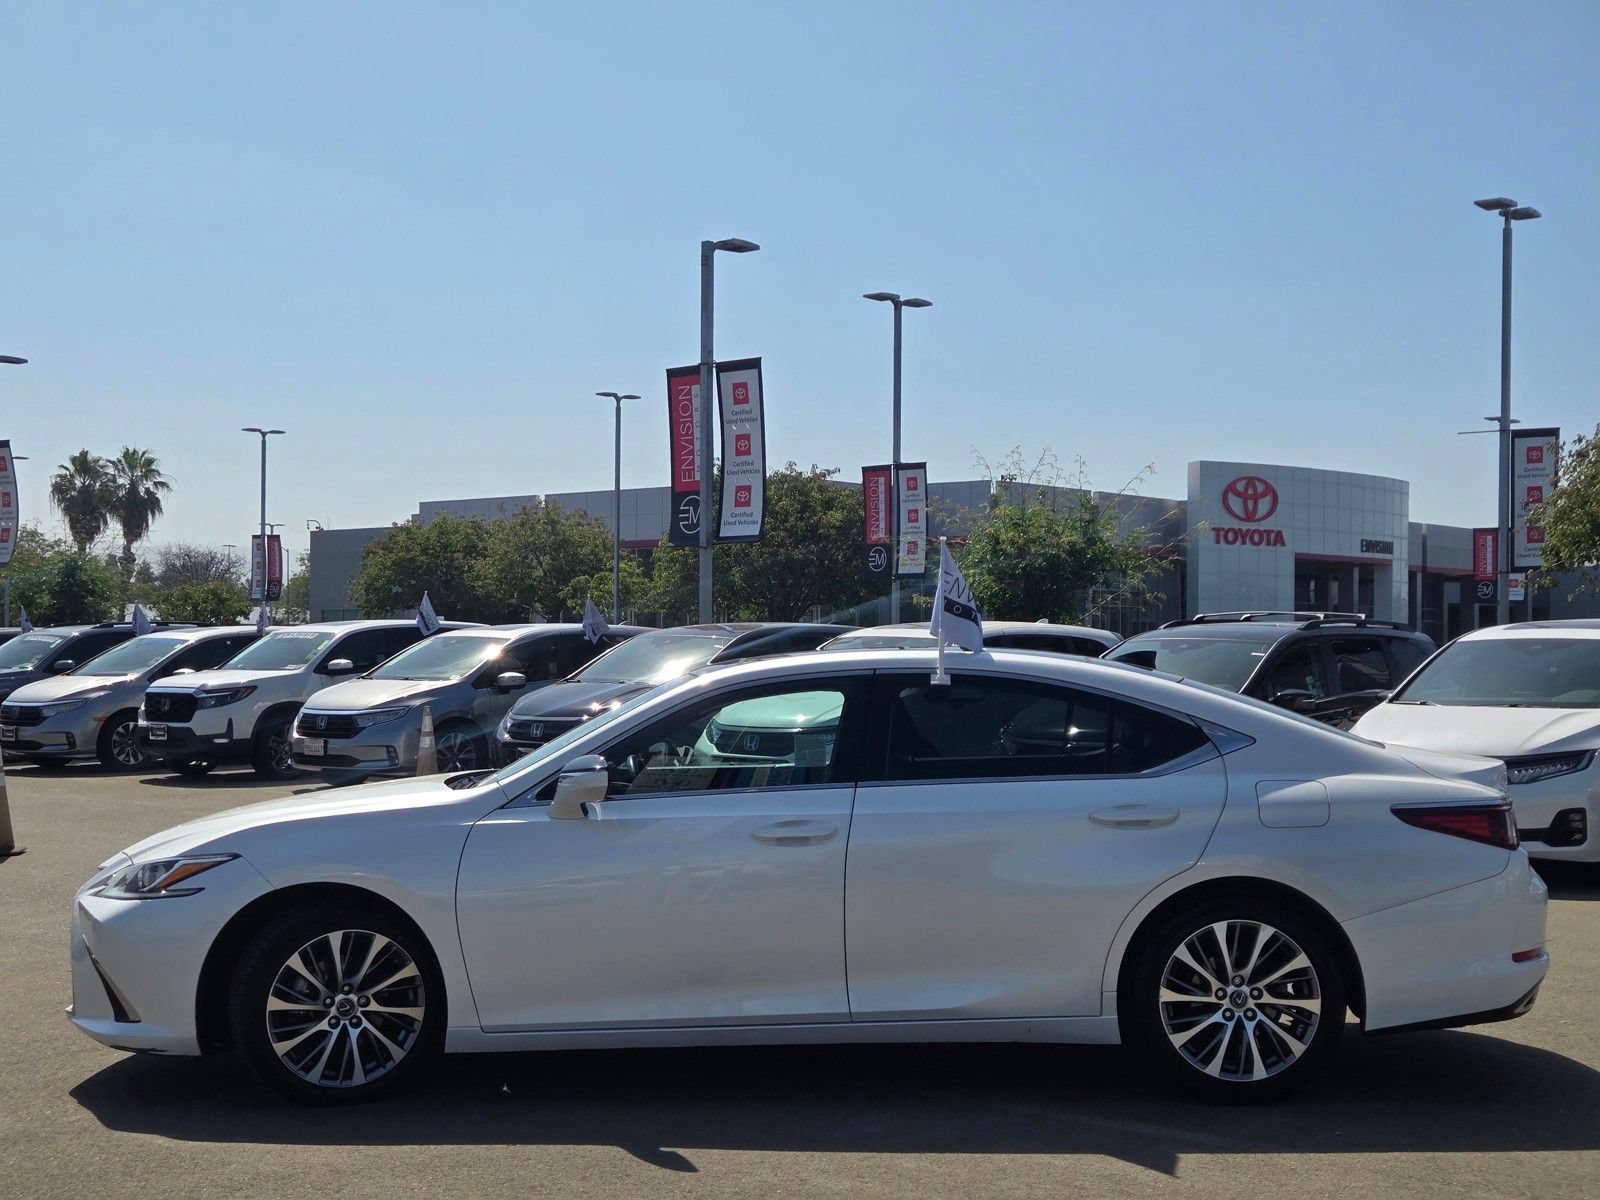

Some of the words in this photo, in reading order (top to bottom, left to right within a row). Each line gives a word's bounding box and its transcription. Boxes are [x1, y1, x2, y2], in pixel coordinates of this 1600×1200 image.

[731, 408, 753, 417] Certified
[739, 416, 759, 424] Vehicles
[679, 385, 693, 483] ENVISION
[732, 460, 755, 468] Certified
[726, 468, 739, 476] Used
[739, 467, 760, 475] Vehicles
[869, 477, 880, 541] ENVISION
[730, 511, 754, 519] Certified
[737, 518, 759, 526] Vehicles
[1211, 527, 1287, 547] TOYOTA
[1478, 536, 1488, 577] ENVISION
